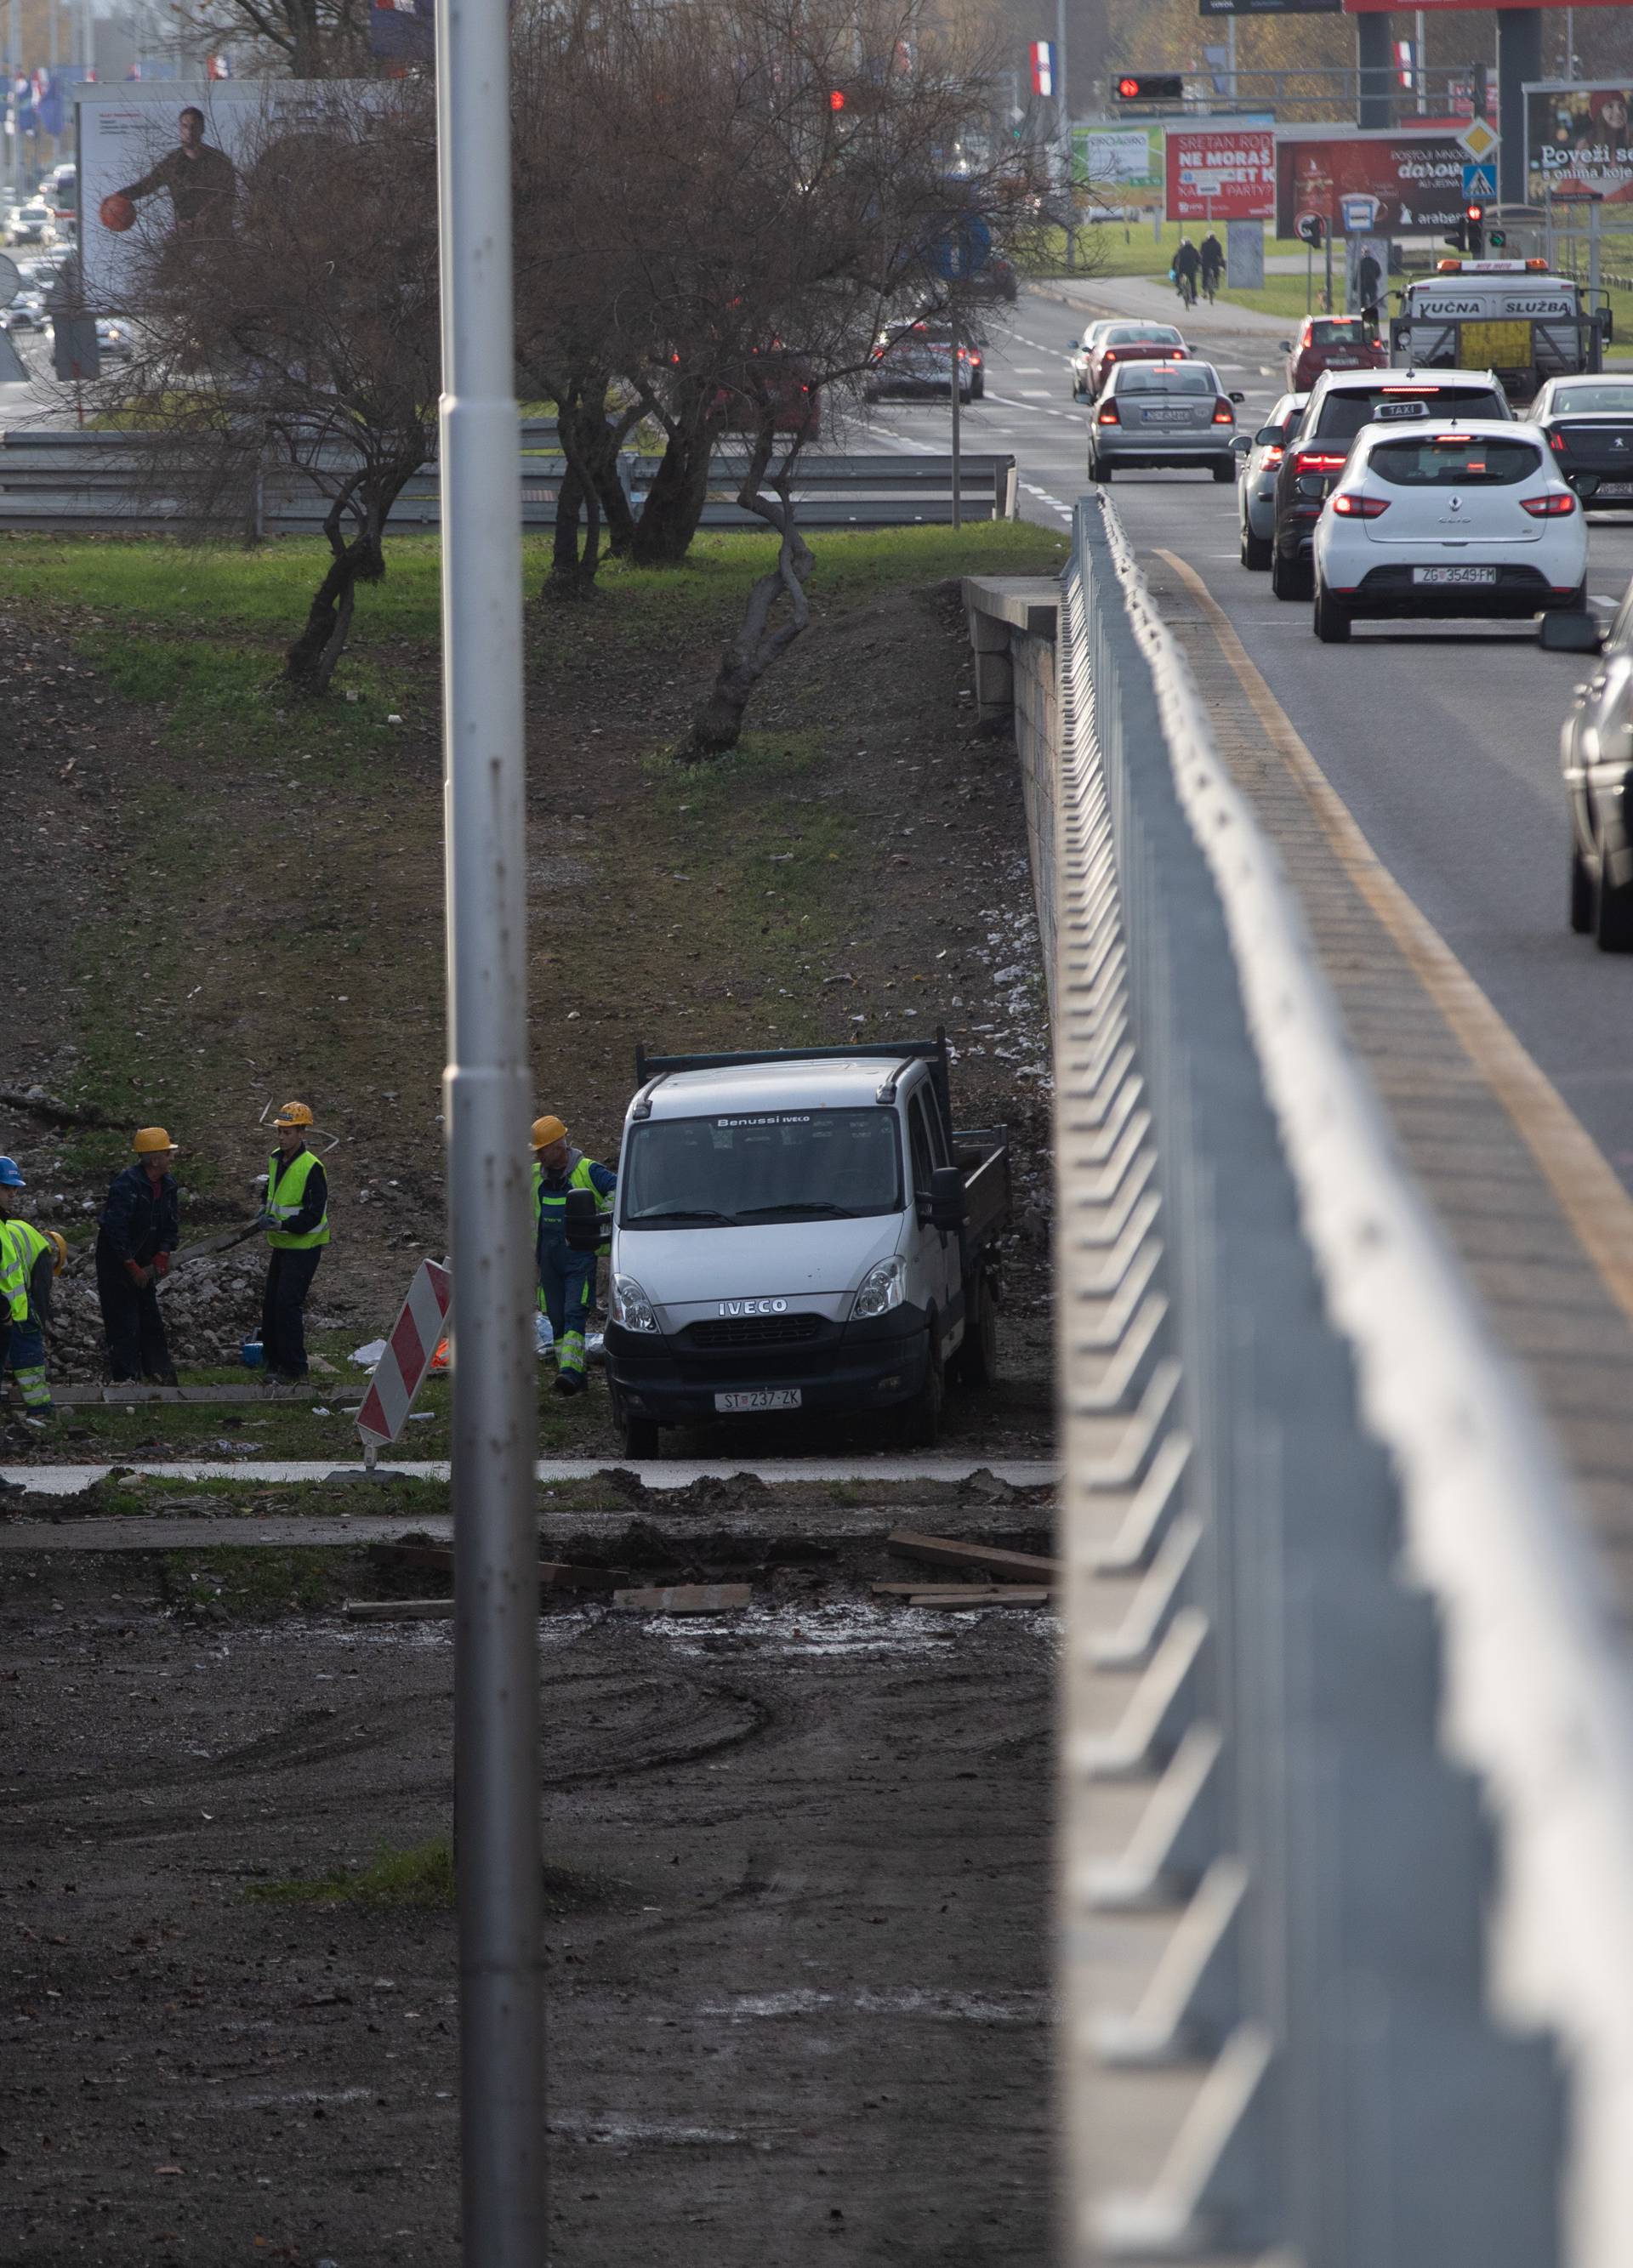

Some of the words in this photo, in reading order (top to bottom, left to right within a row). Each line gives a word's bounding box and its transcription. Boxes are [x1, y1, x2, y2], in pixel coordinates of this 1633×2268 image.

[1179, 151, 1203, 167] NE
[1206, 148, 1271, 167] MORAŠ
[1541, 144, 1611, 165] Poveži
[1420, 299, 1480, 314] VUČNA
[1505, 299, 1569, 313] SLUŽBA
[1388, 406, 1414, 415] TAXI
[1423, 569, 1438, 581] ZG
[717, 1116, 780, 1127] Benussi
[718, 1299, 788, 1316] IVECO
[724, 1394, 740, 1408] ST
[750, 1390, 799, 1407] 237-ZK
